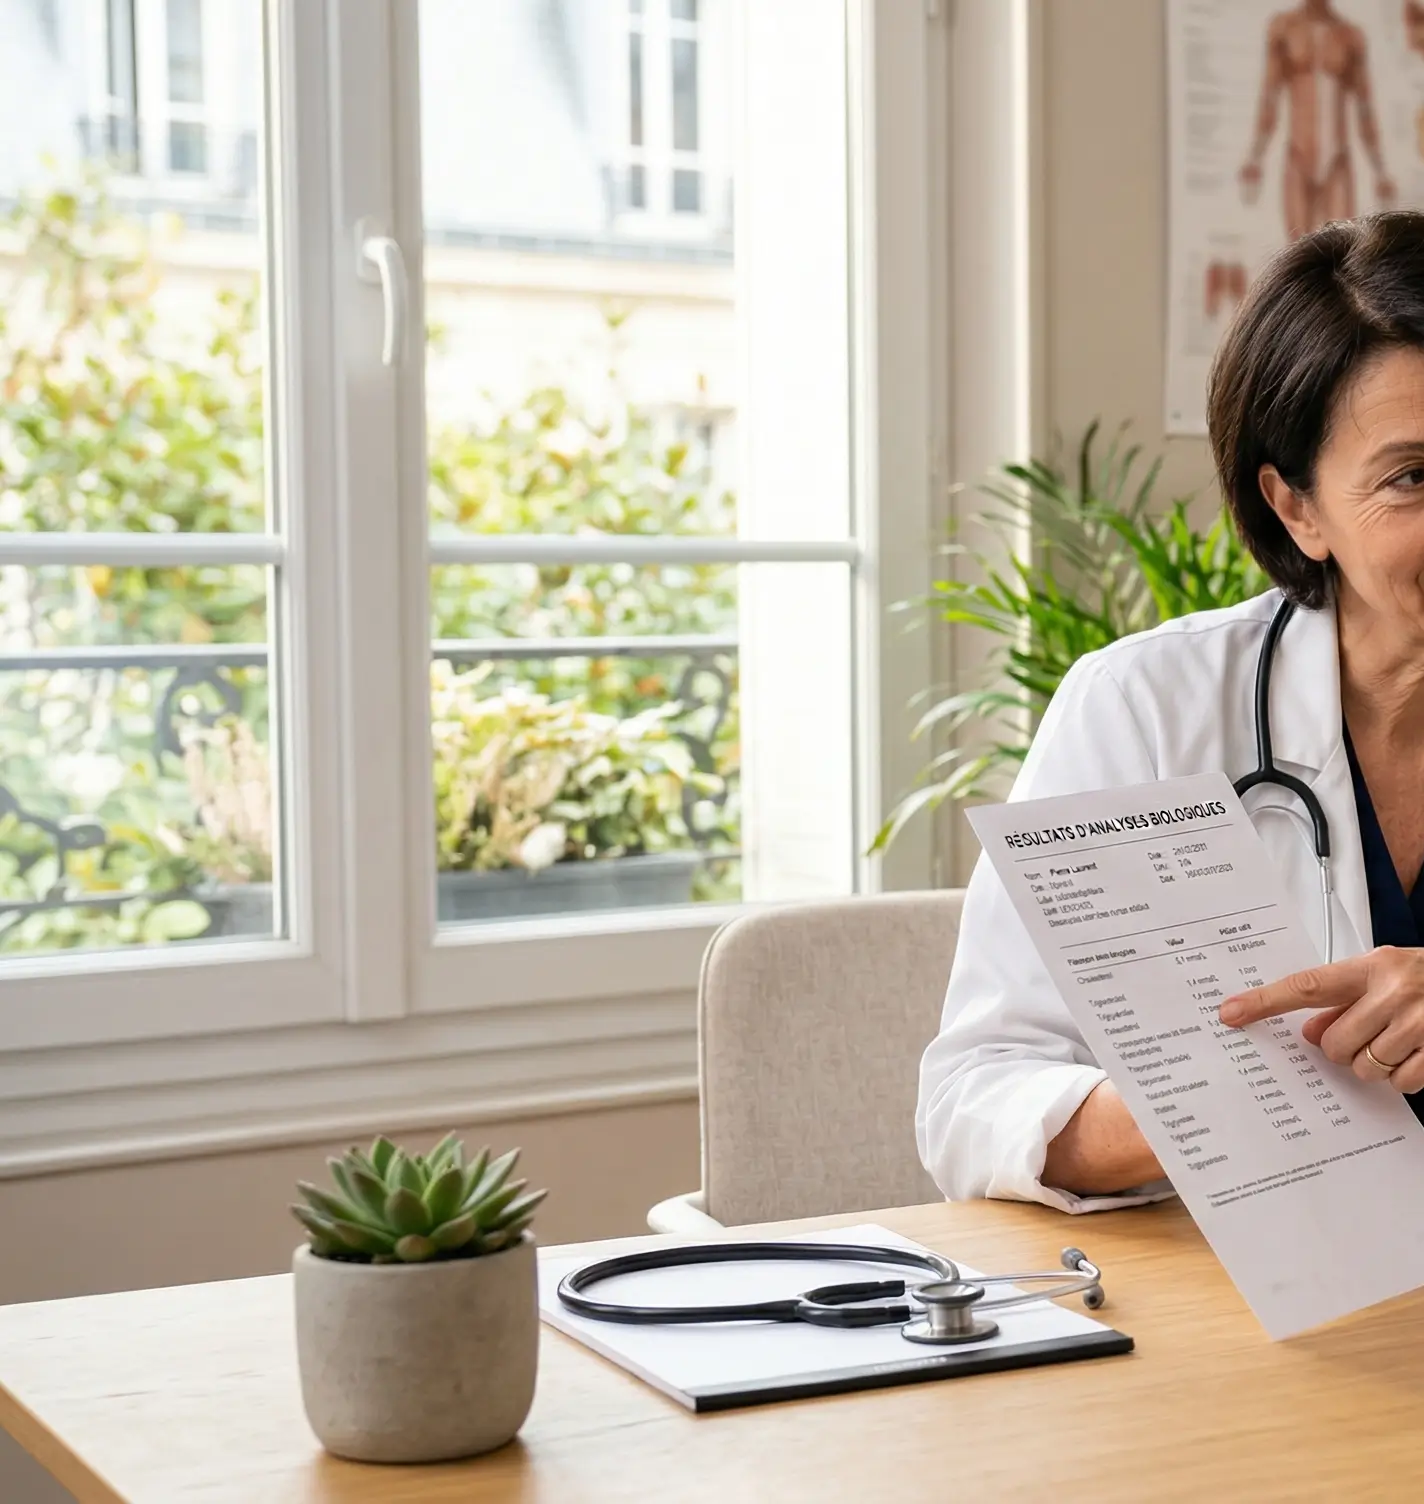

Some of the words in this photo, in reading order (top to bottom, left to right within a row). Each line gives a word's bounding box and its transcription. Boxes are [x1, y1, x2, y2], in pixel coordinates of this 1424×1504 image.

[1005, 826, 1075, 849] RÉSULTATS
[1075, 813, 1150, 839] D'ANALYSES
[1149, 801, 1227, 826] BIOLOGIQUES
